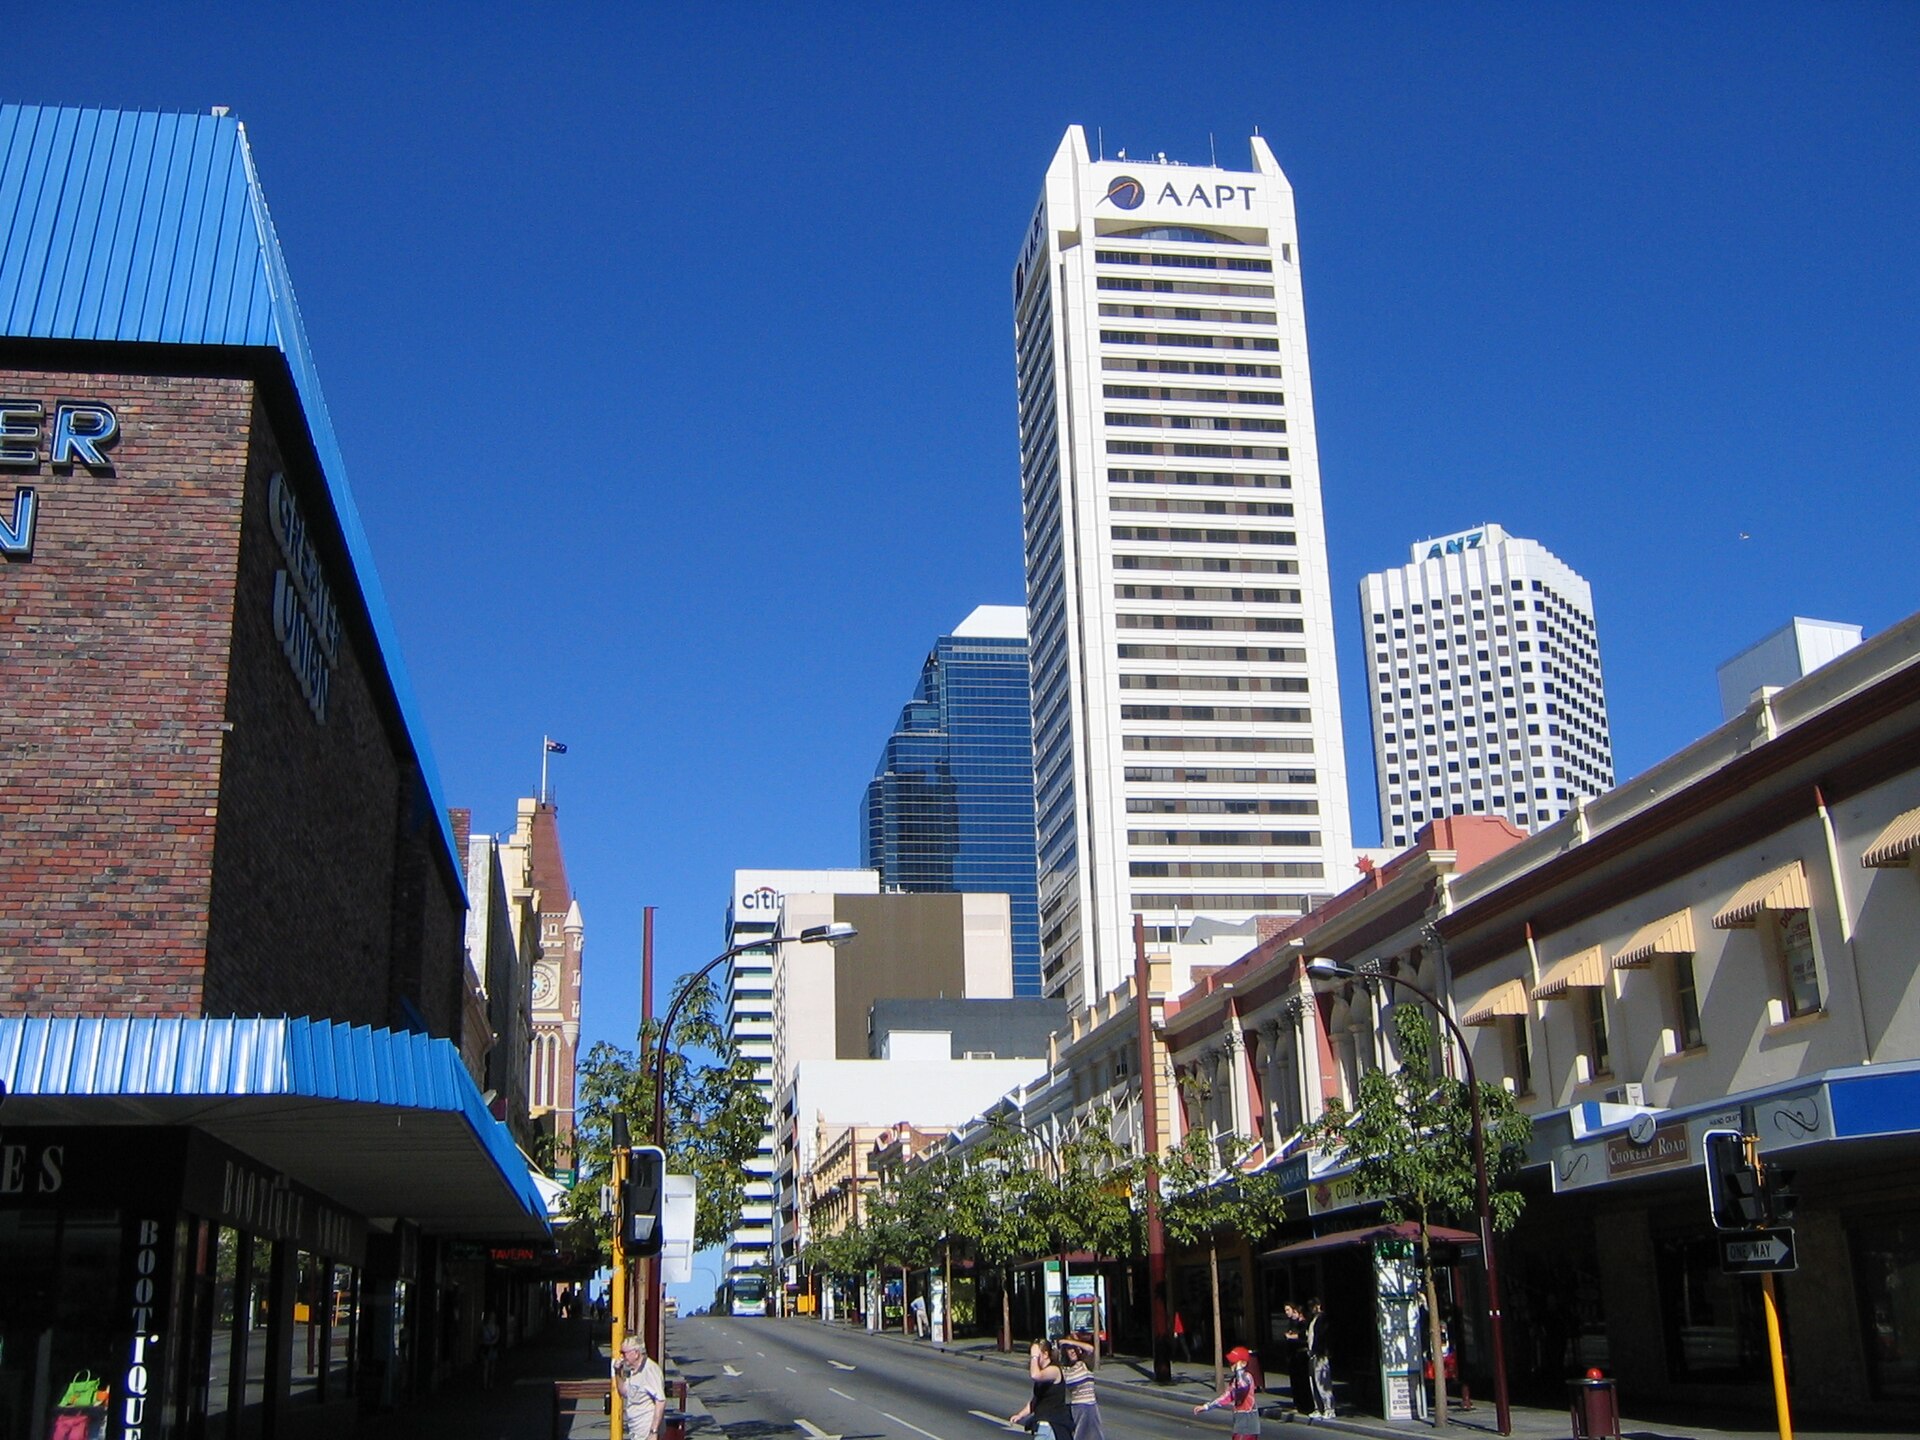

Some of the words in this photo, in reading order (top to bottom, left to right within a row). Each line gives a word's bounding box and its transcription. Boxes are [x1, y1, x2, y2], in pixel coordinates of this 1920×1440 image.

[1156, 181, 1257, 211] AAPT
[1426, 532, 1483, 559] ANZ
[1658, 1137, 1686, 1156] ROAD
[489, 1248, 535, 1261] TAVERN
[1730, 1244, 1747, 1259] ONE
[1751, 1243, 1771, 1259] WAY
